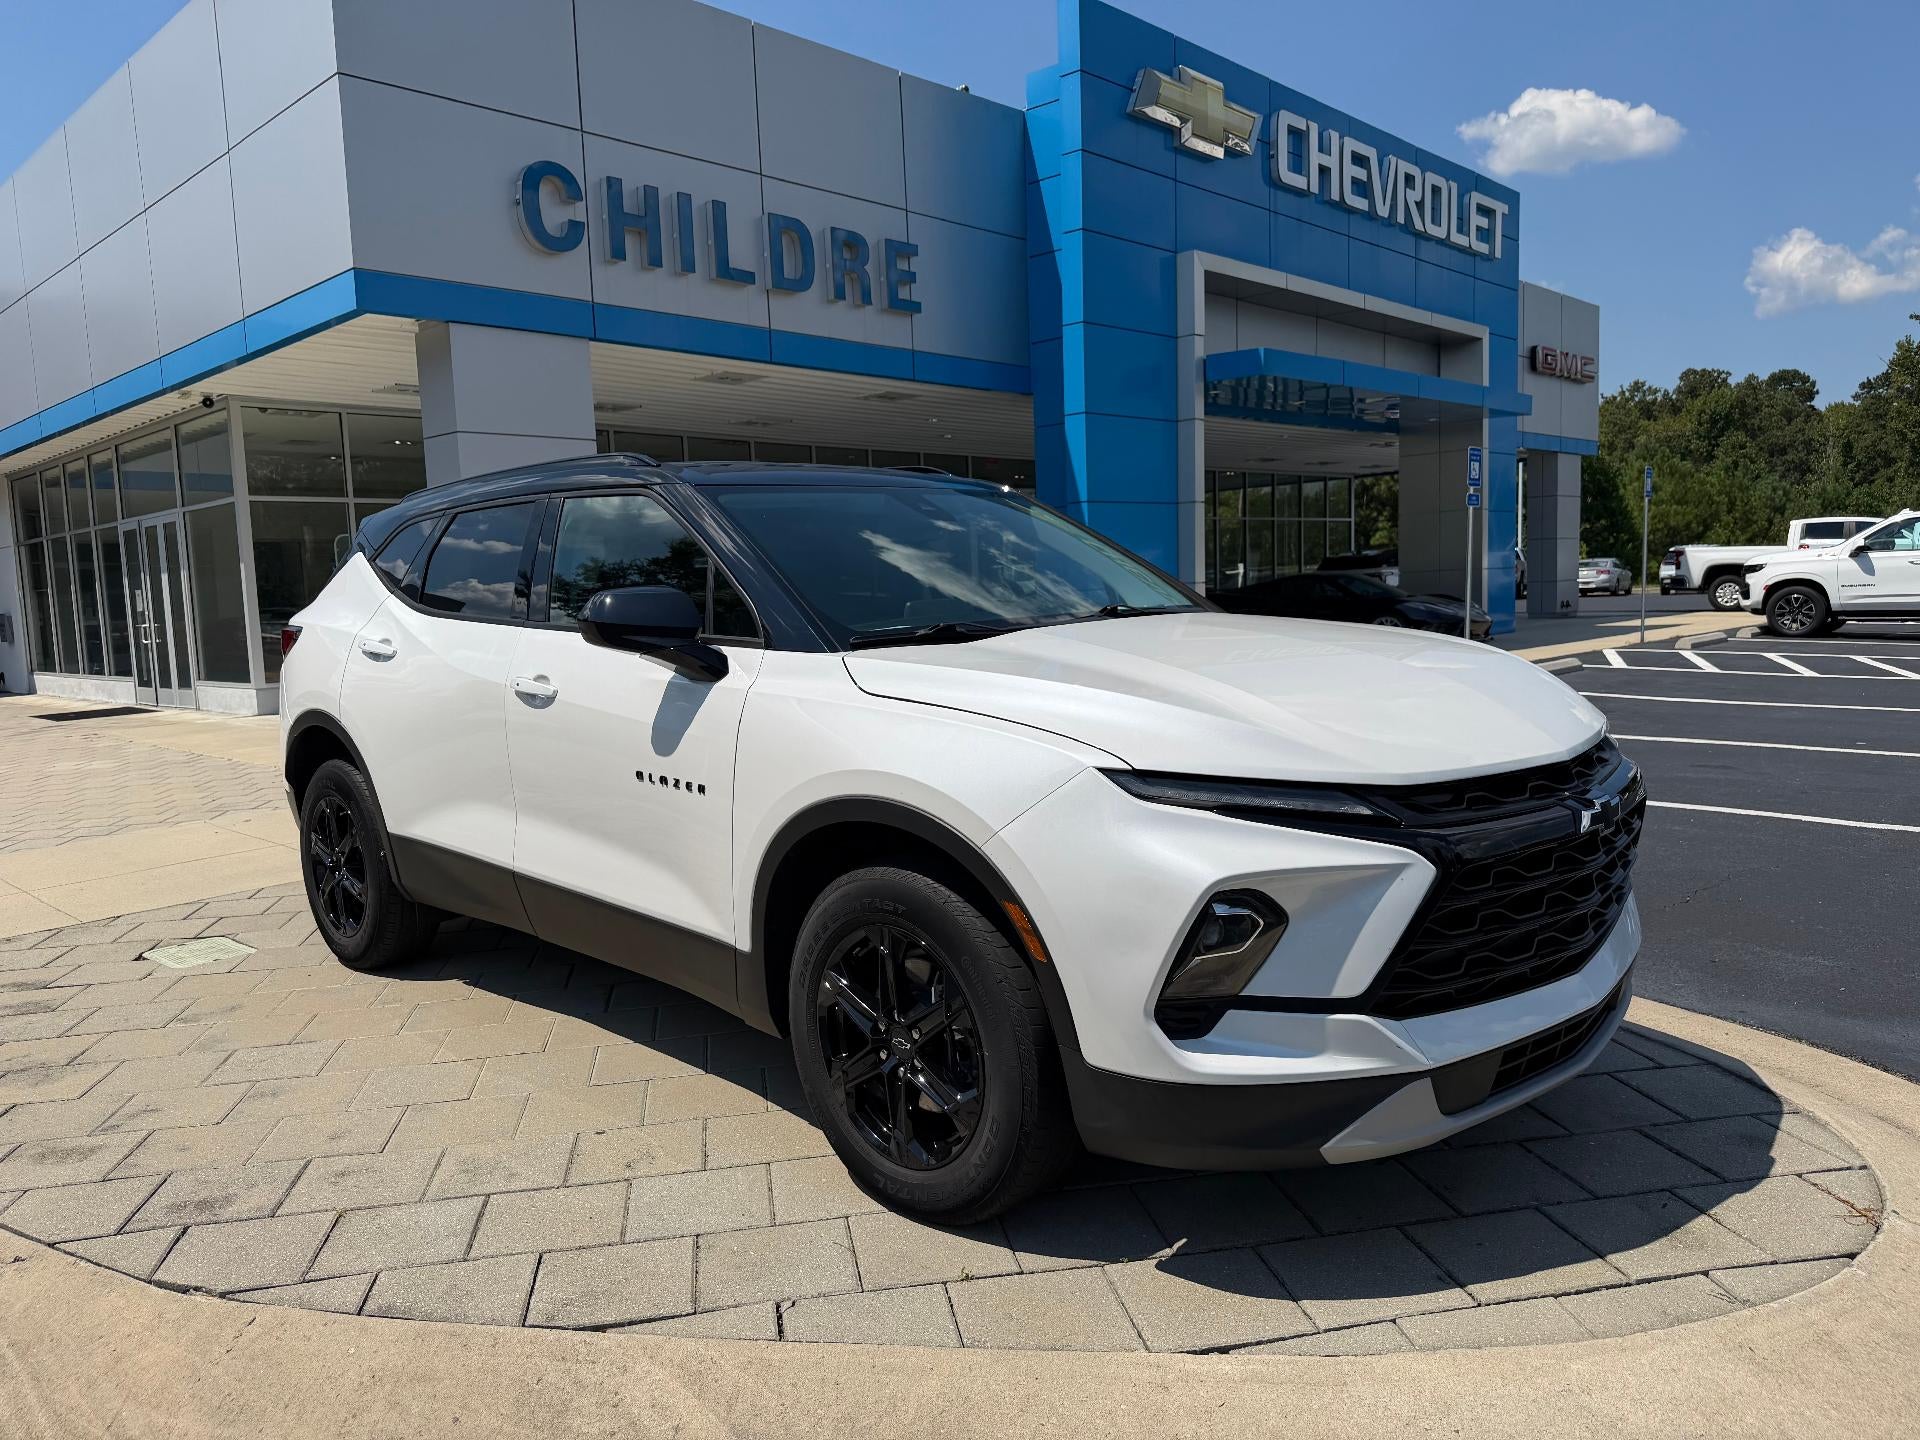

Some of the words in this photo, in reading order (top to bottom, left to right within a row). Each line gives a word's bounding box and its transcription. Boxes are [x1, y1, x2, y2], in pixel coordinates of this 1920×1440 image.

[1270, 109, 1509, 260] CHEVROLET
[514, 160, 922, 315] CHILDRE
[1535, 344, 1596, 384] GMC
[635, 770, 706, 796] BLAZER
